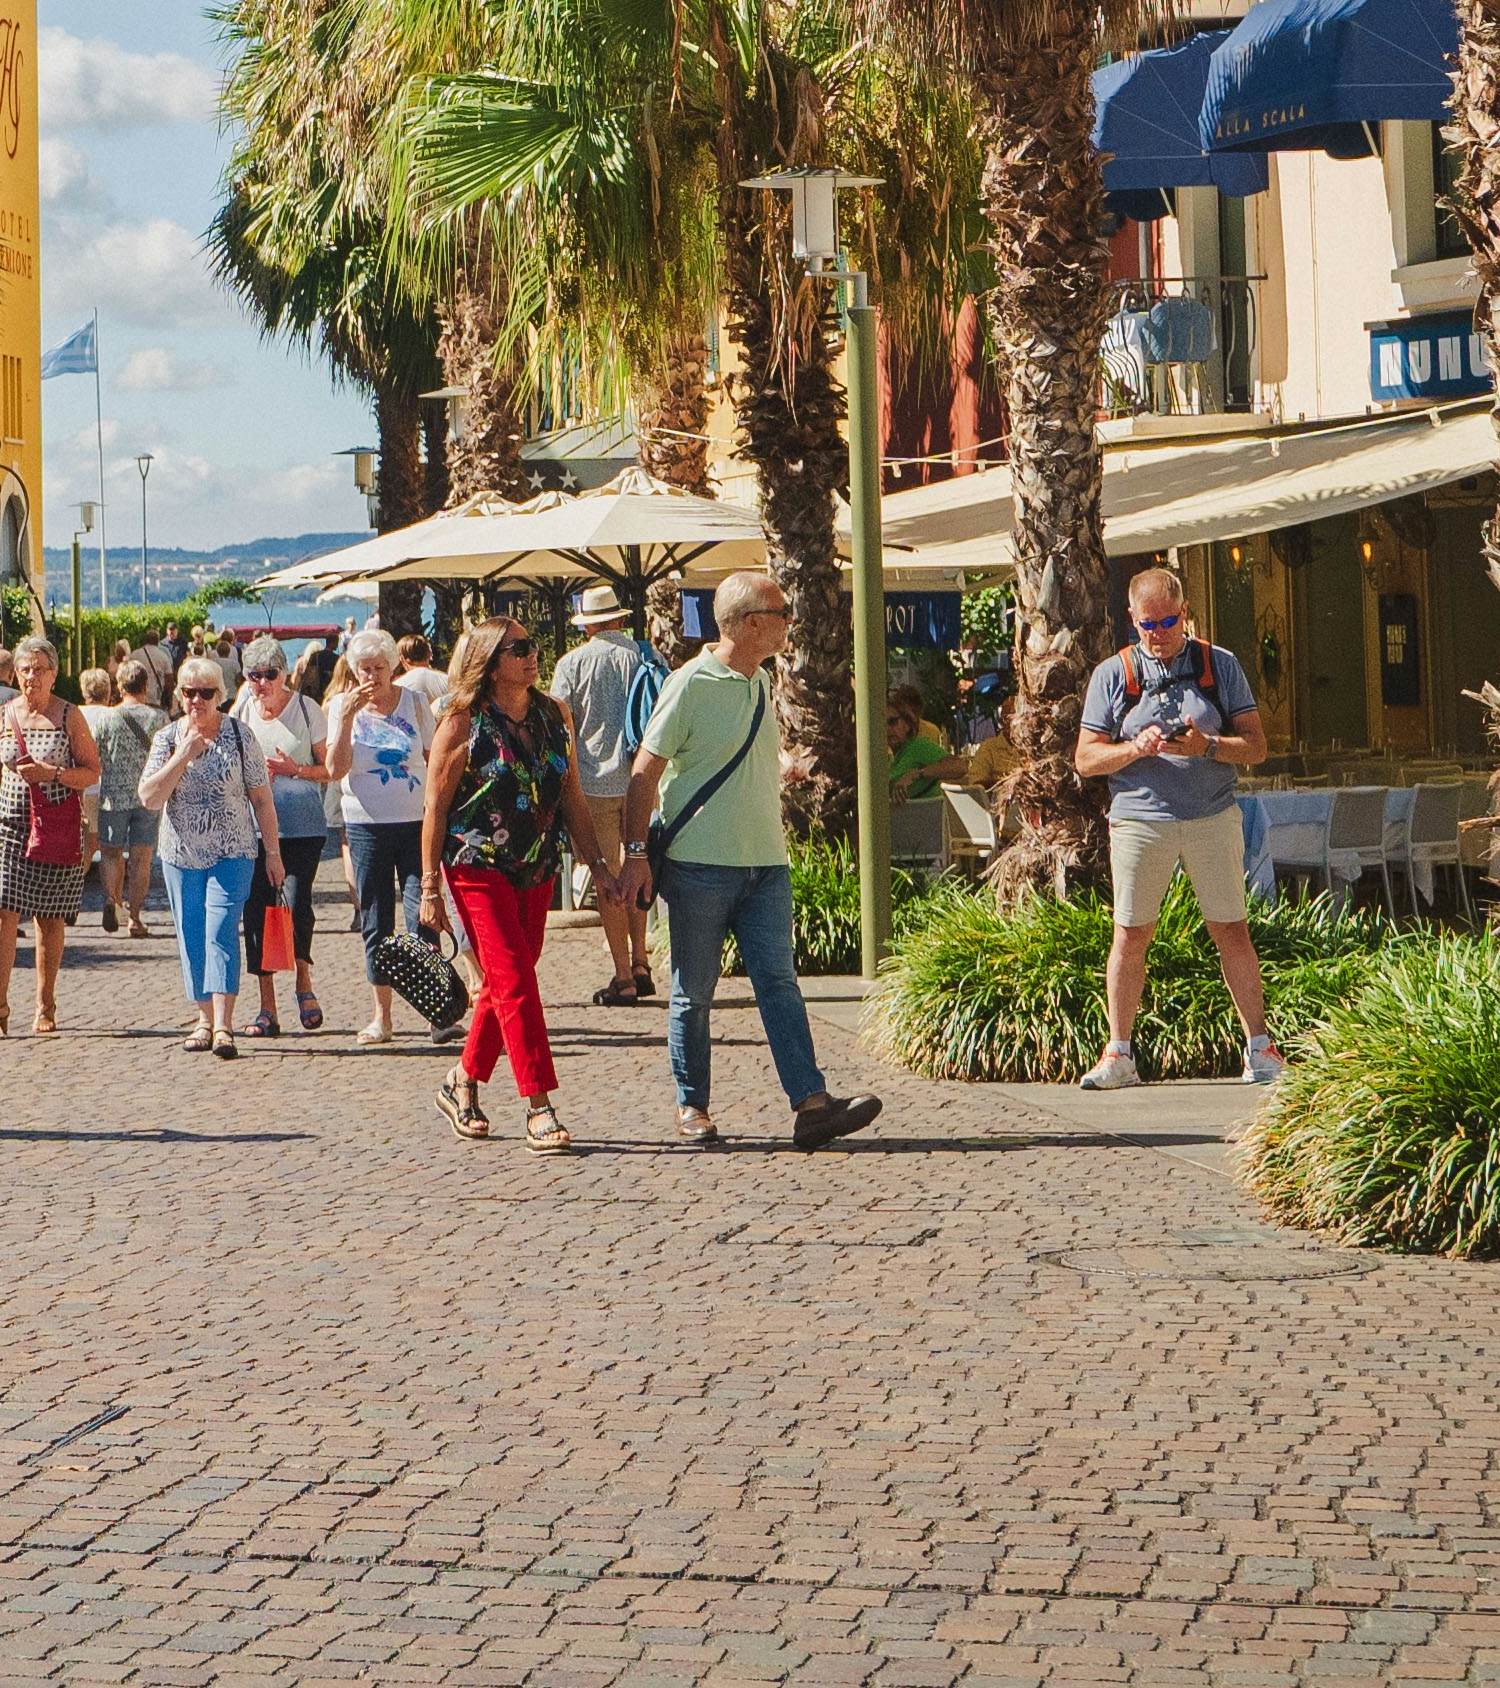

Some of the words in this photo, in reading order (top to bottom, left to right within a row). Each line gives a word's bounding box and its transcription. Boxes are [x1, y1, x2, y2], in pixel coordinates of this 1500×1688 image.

[1215, 118, 1251, 139] ALLA
[1262, 103, 1306, 130] SCALA
[1379, 333, 1491, 387] NUNU
[885, 604, 917, 635] ROT
